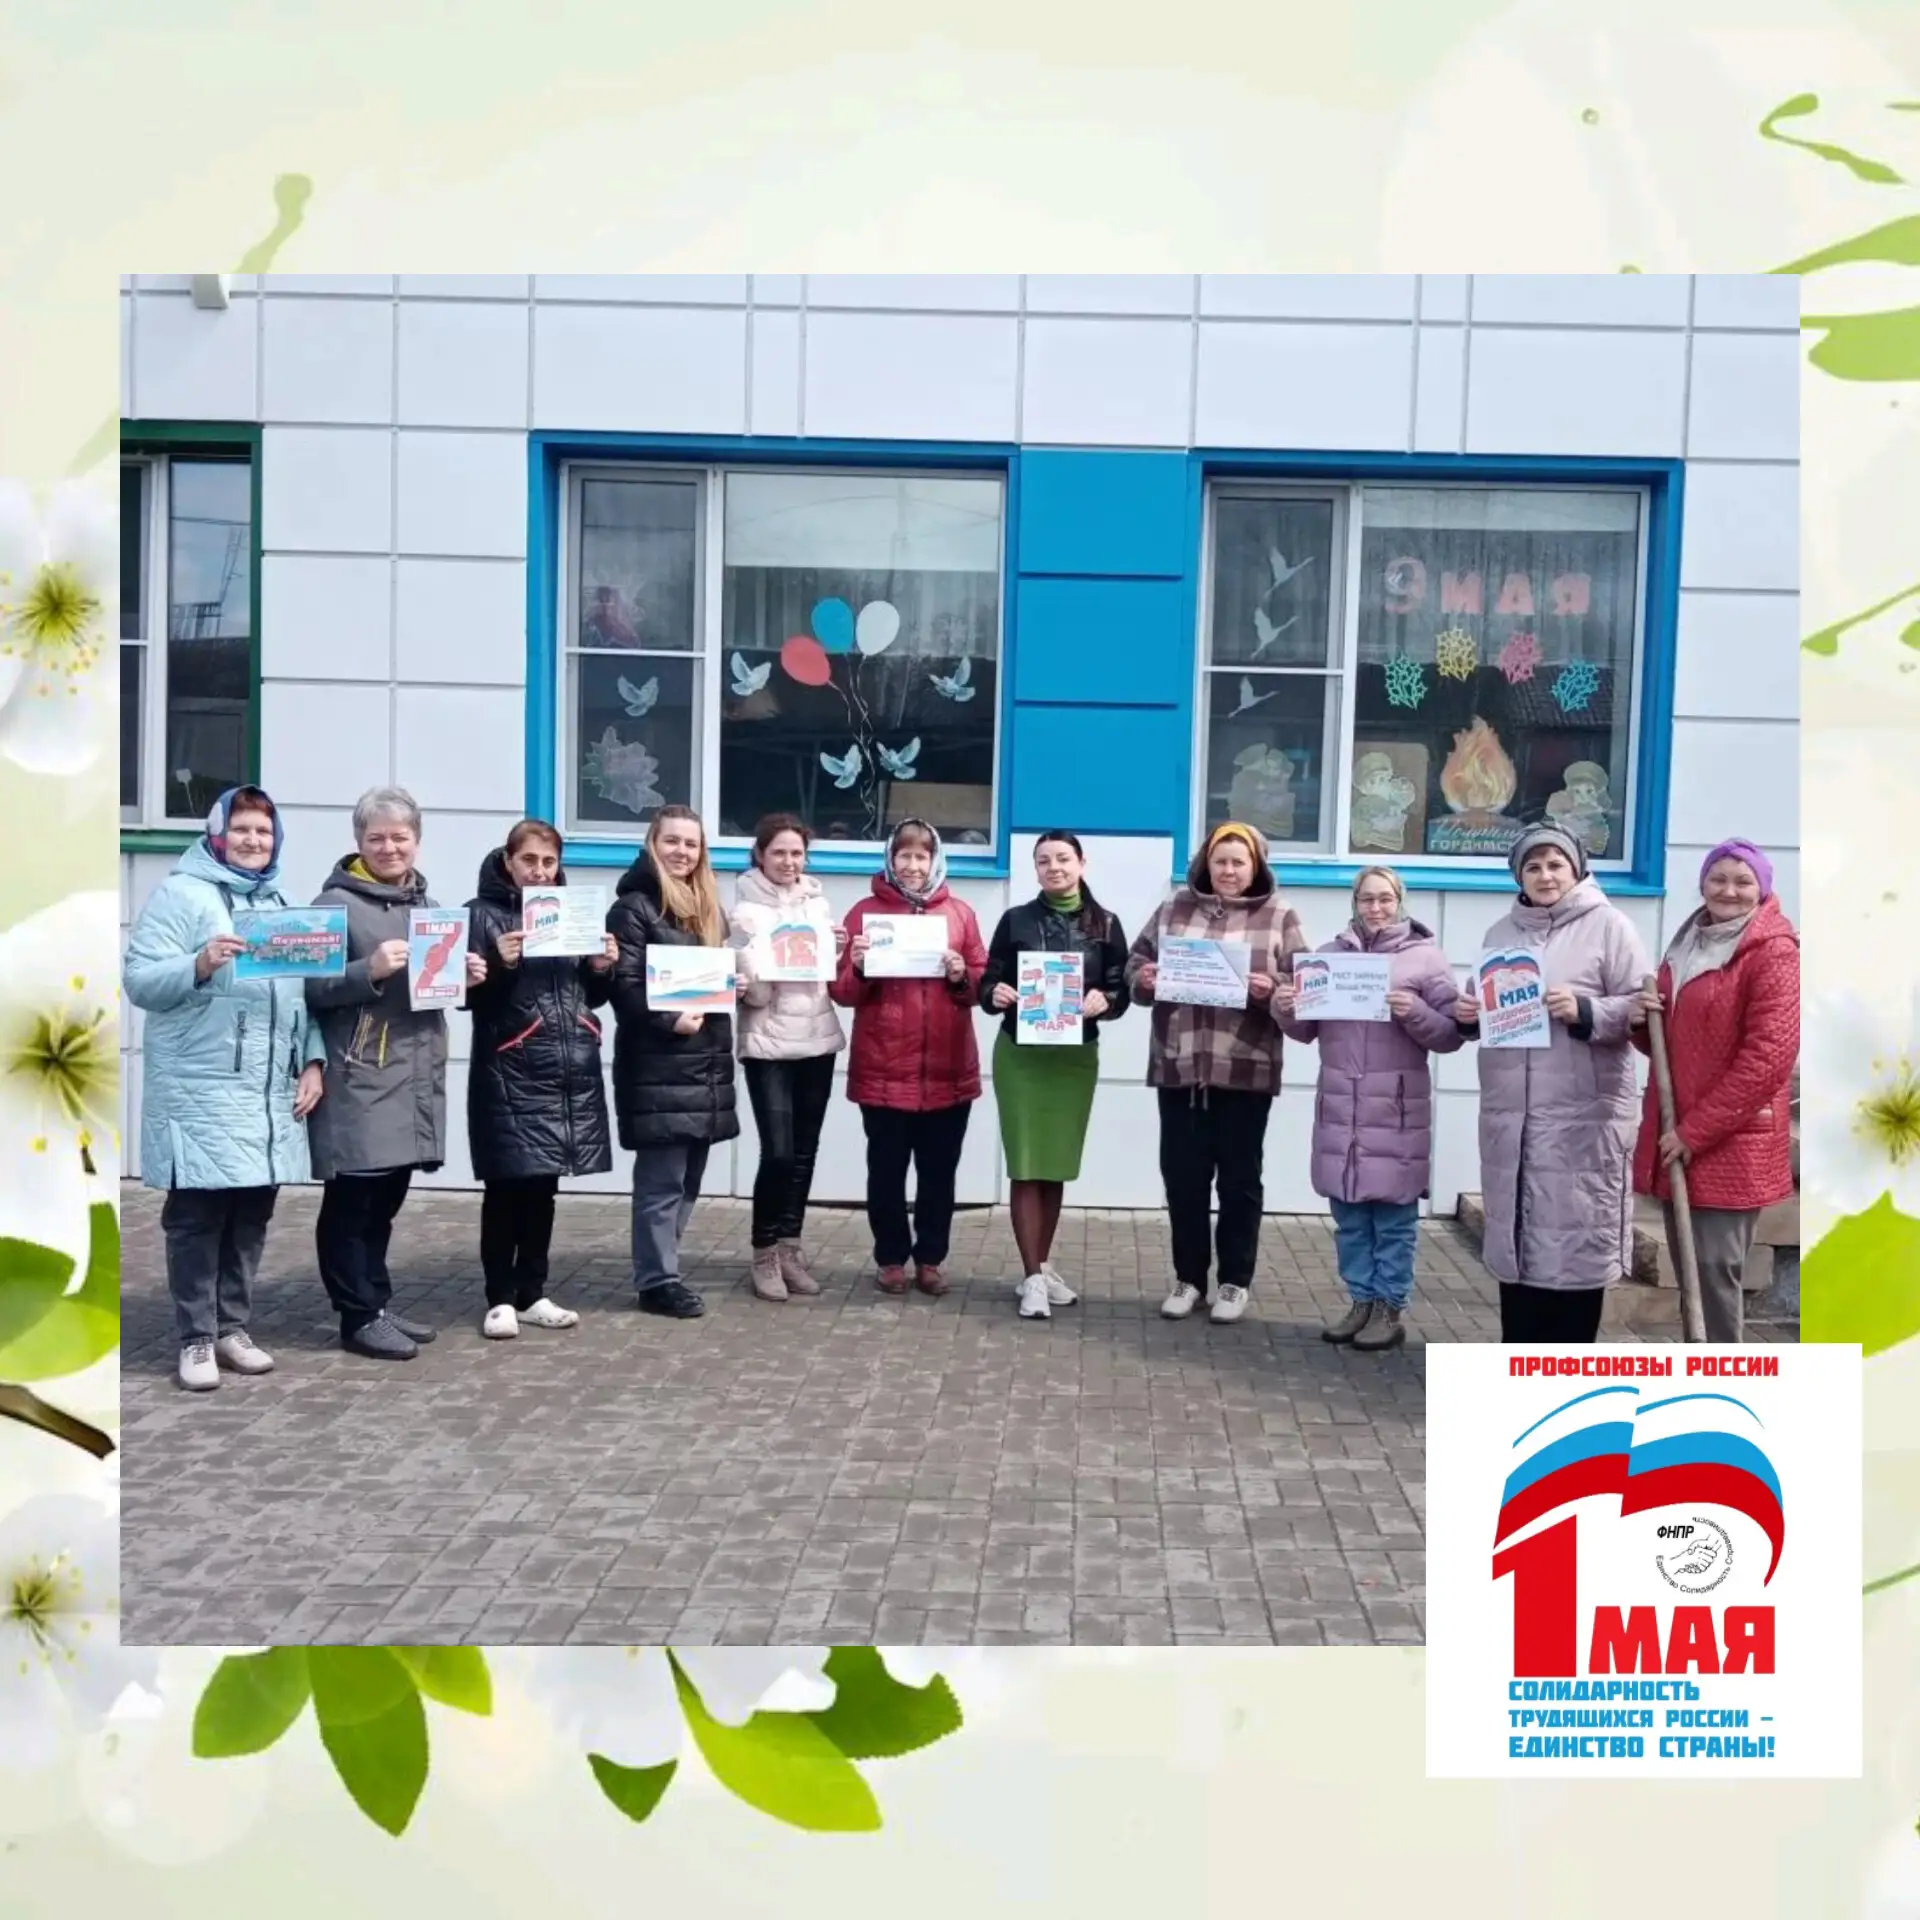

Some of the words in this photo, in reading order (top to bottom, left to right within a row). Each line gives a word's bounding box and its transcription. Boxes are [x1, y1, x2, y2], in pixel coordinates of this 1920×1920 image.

[1384, 556, 1427, 614] 9
[1430, 840, 1515, 854] ГОРДИМС
[1480, 976, 1498, 1012] 1
[1499, 984, 1540, 1008] МАЯ
[1035, 1020, 1065, 1033] МАЯ
